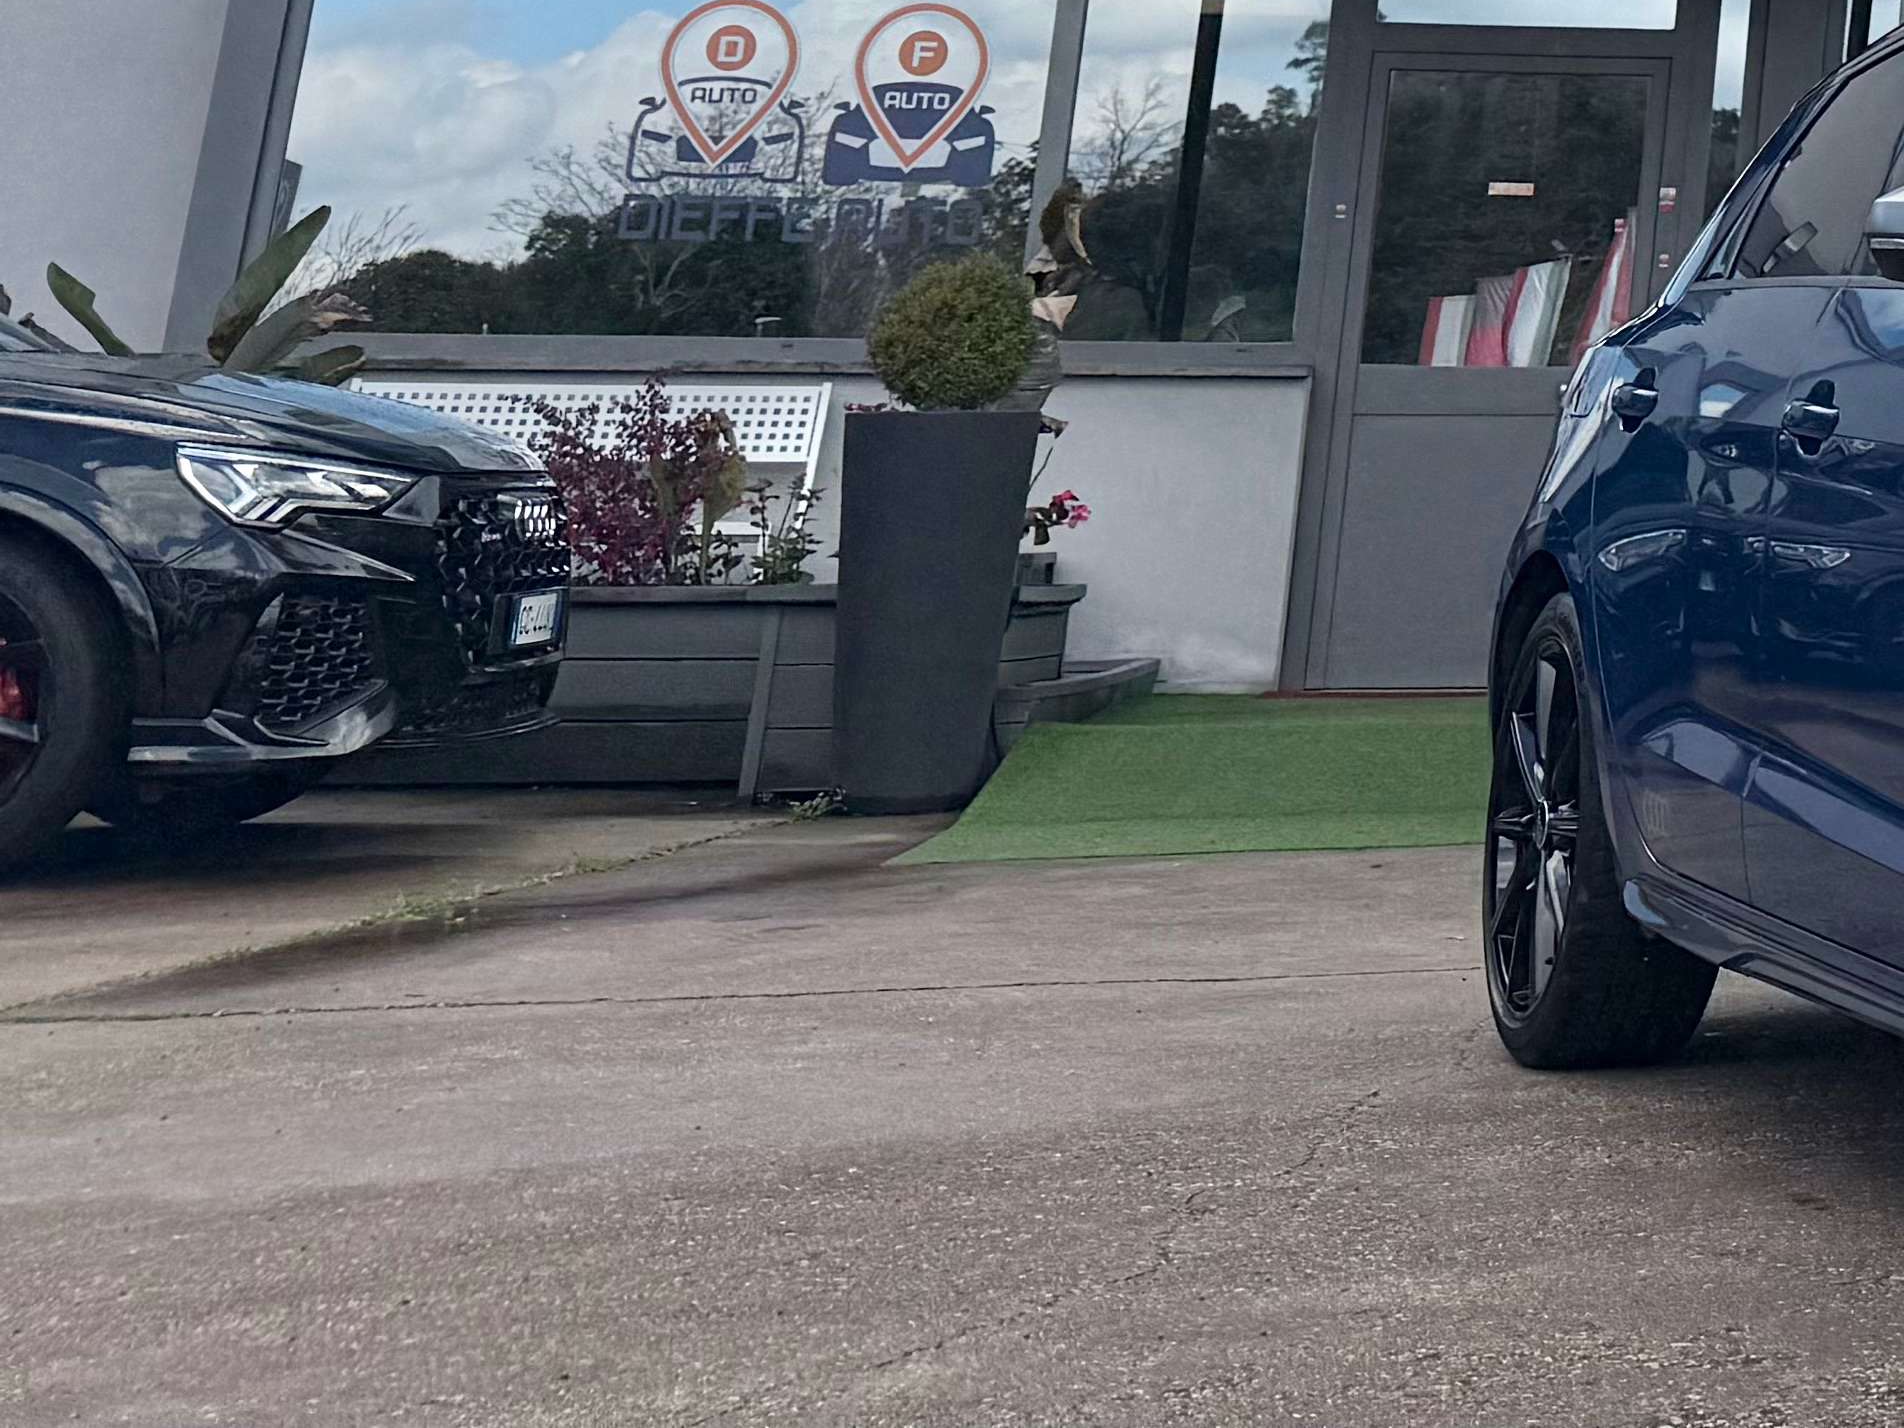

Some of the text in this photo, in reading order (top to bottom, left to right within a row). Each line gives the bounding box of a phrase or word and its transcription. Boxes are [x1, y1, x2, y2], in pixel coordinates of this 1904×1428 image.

[716, 36, 744, 63] D
[911, 42, 938, 68] F
[691, 88, 757, 105] AUTO
[884, 91, 951, 111] AUTO
